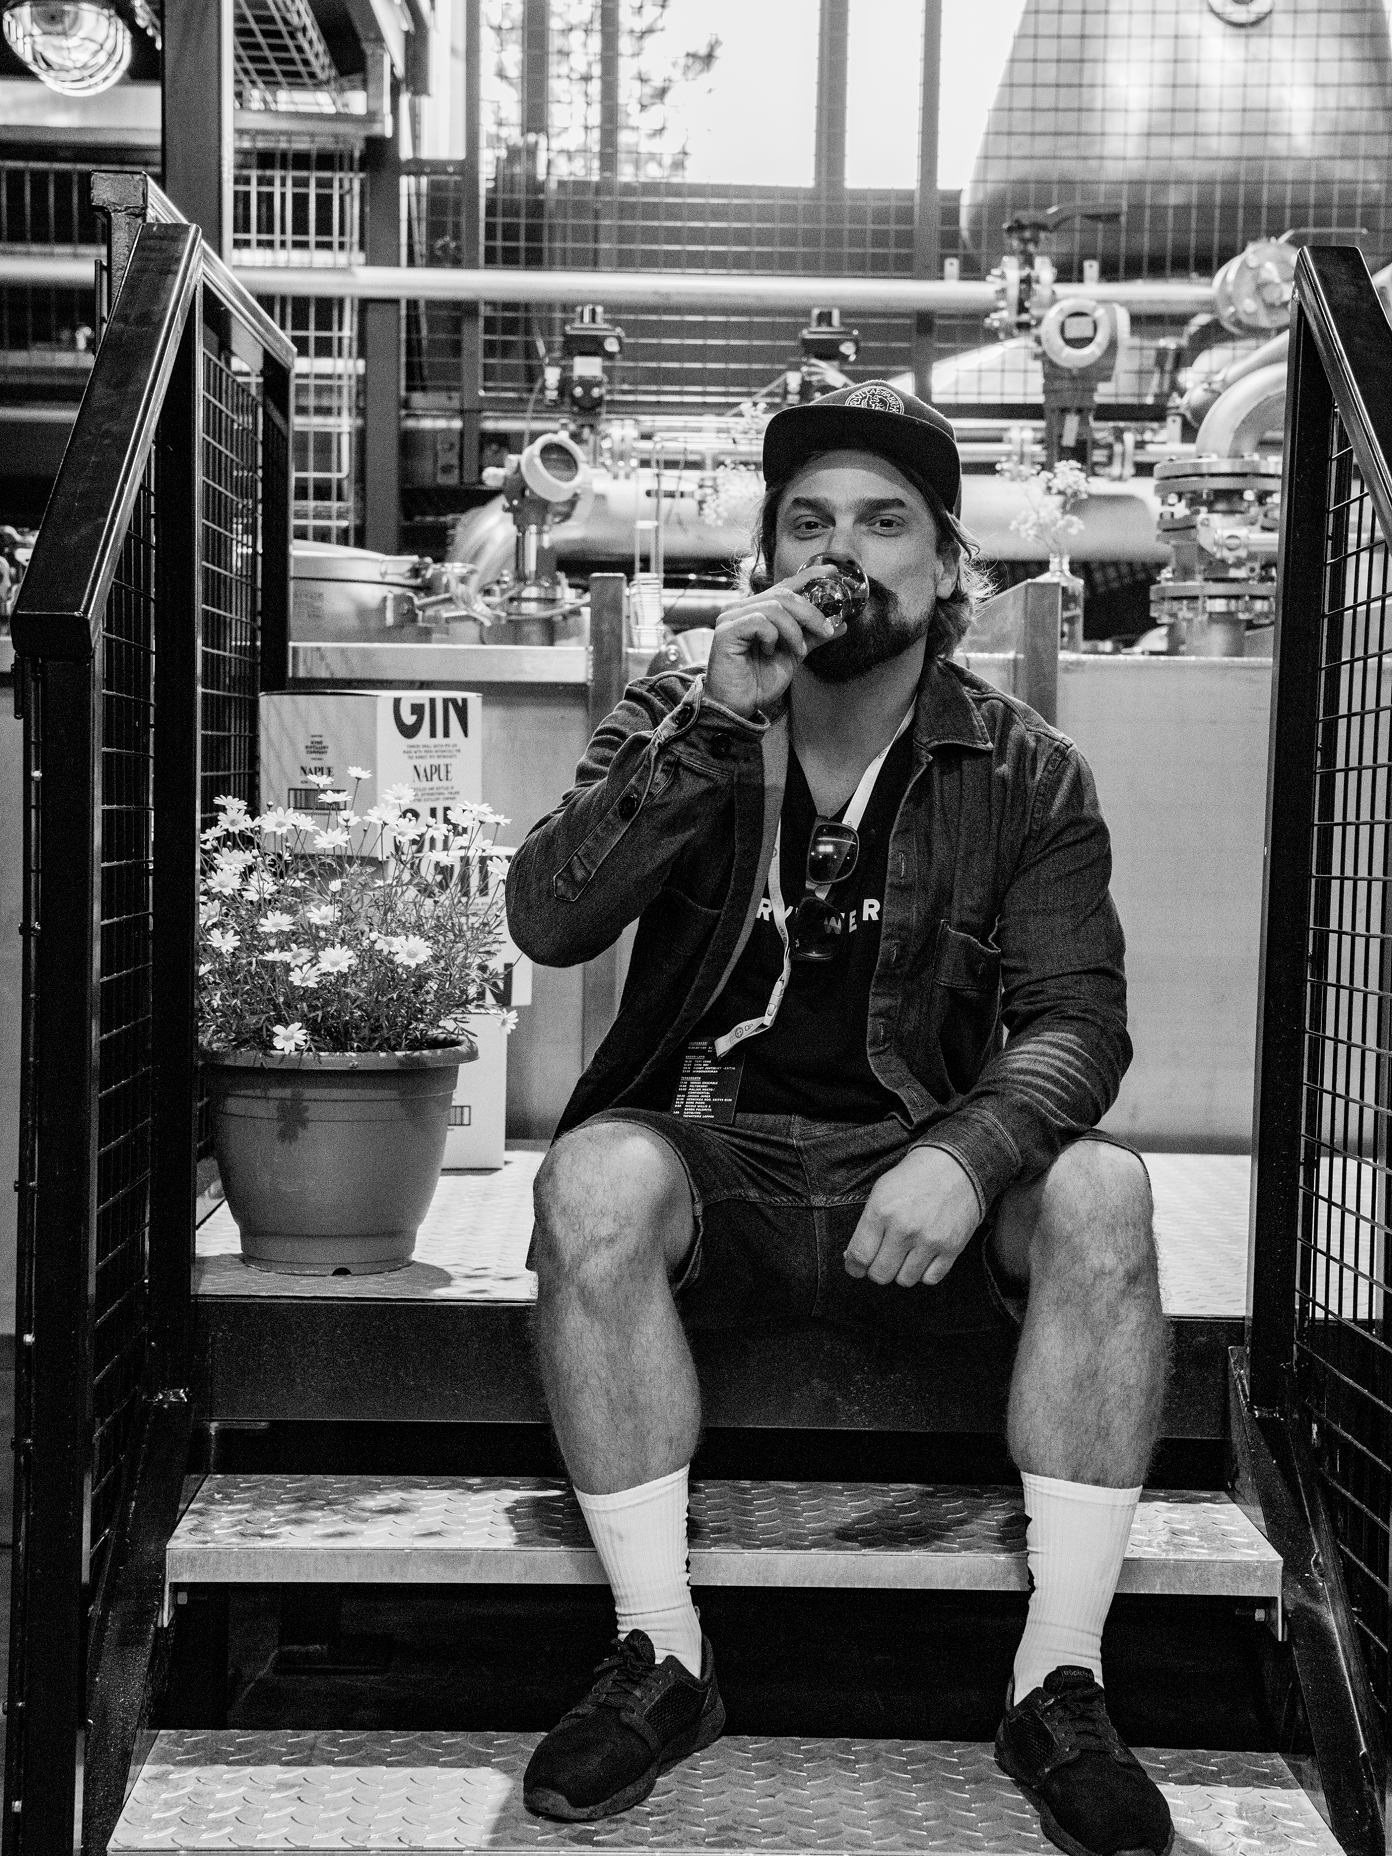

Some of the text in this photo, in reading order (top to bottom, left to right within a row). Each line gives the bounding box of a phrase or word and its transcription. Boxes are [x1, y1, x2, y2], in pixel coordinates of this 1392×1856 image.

[393, 697, 468, 739] GIN
[300, 766, 334, 777] NAPUE
[412, 763, 453, 783] NAPUE
